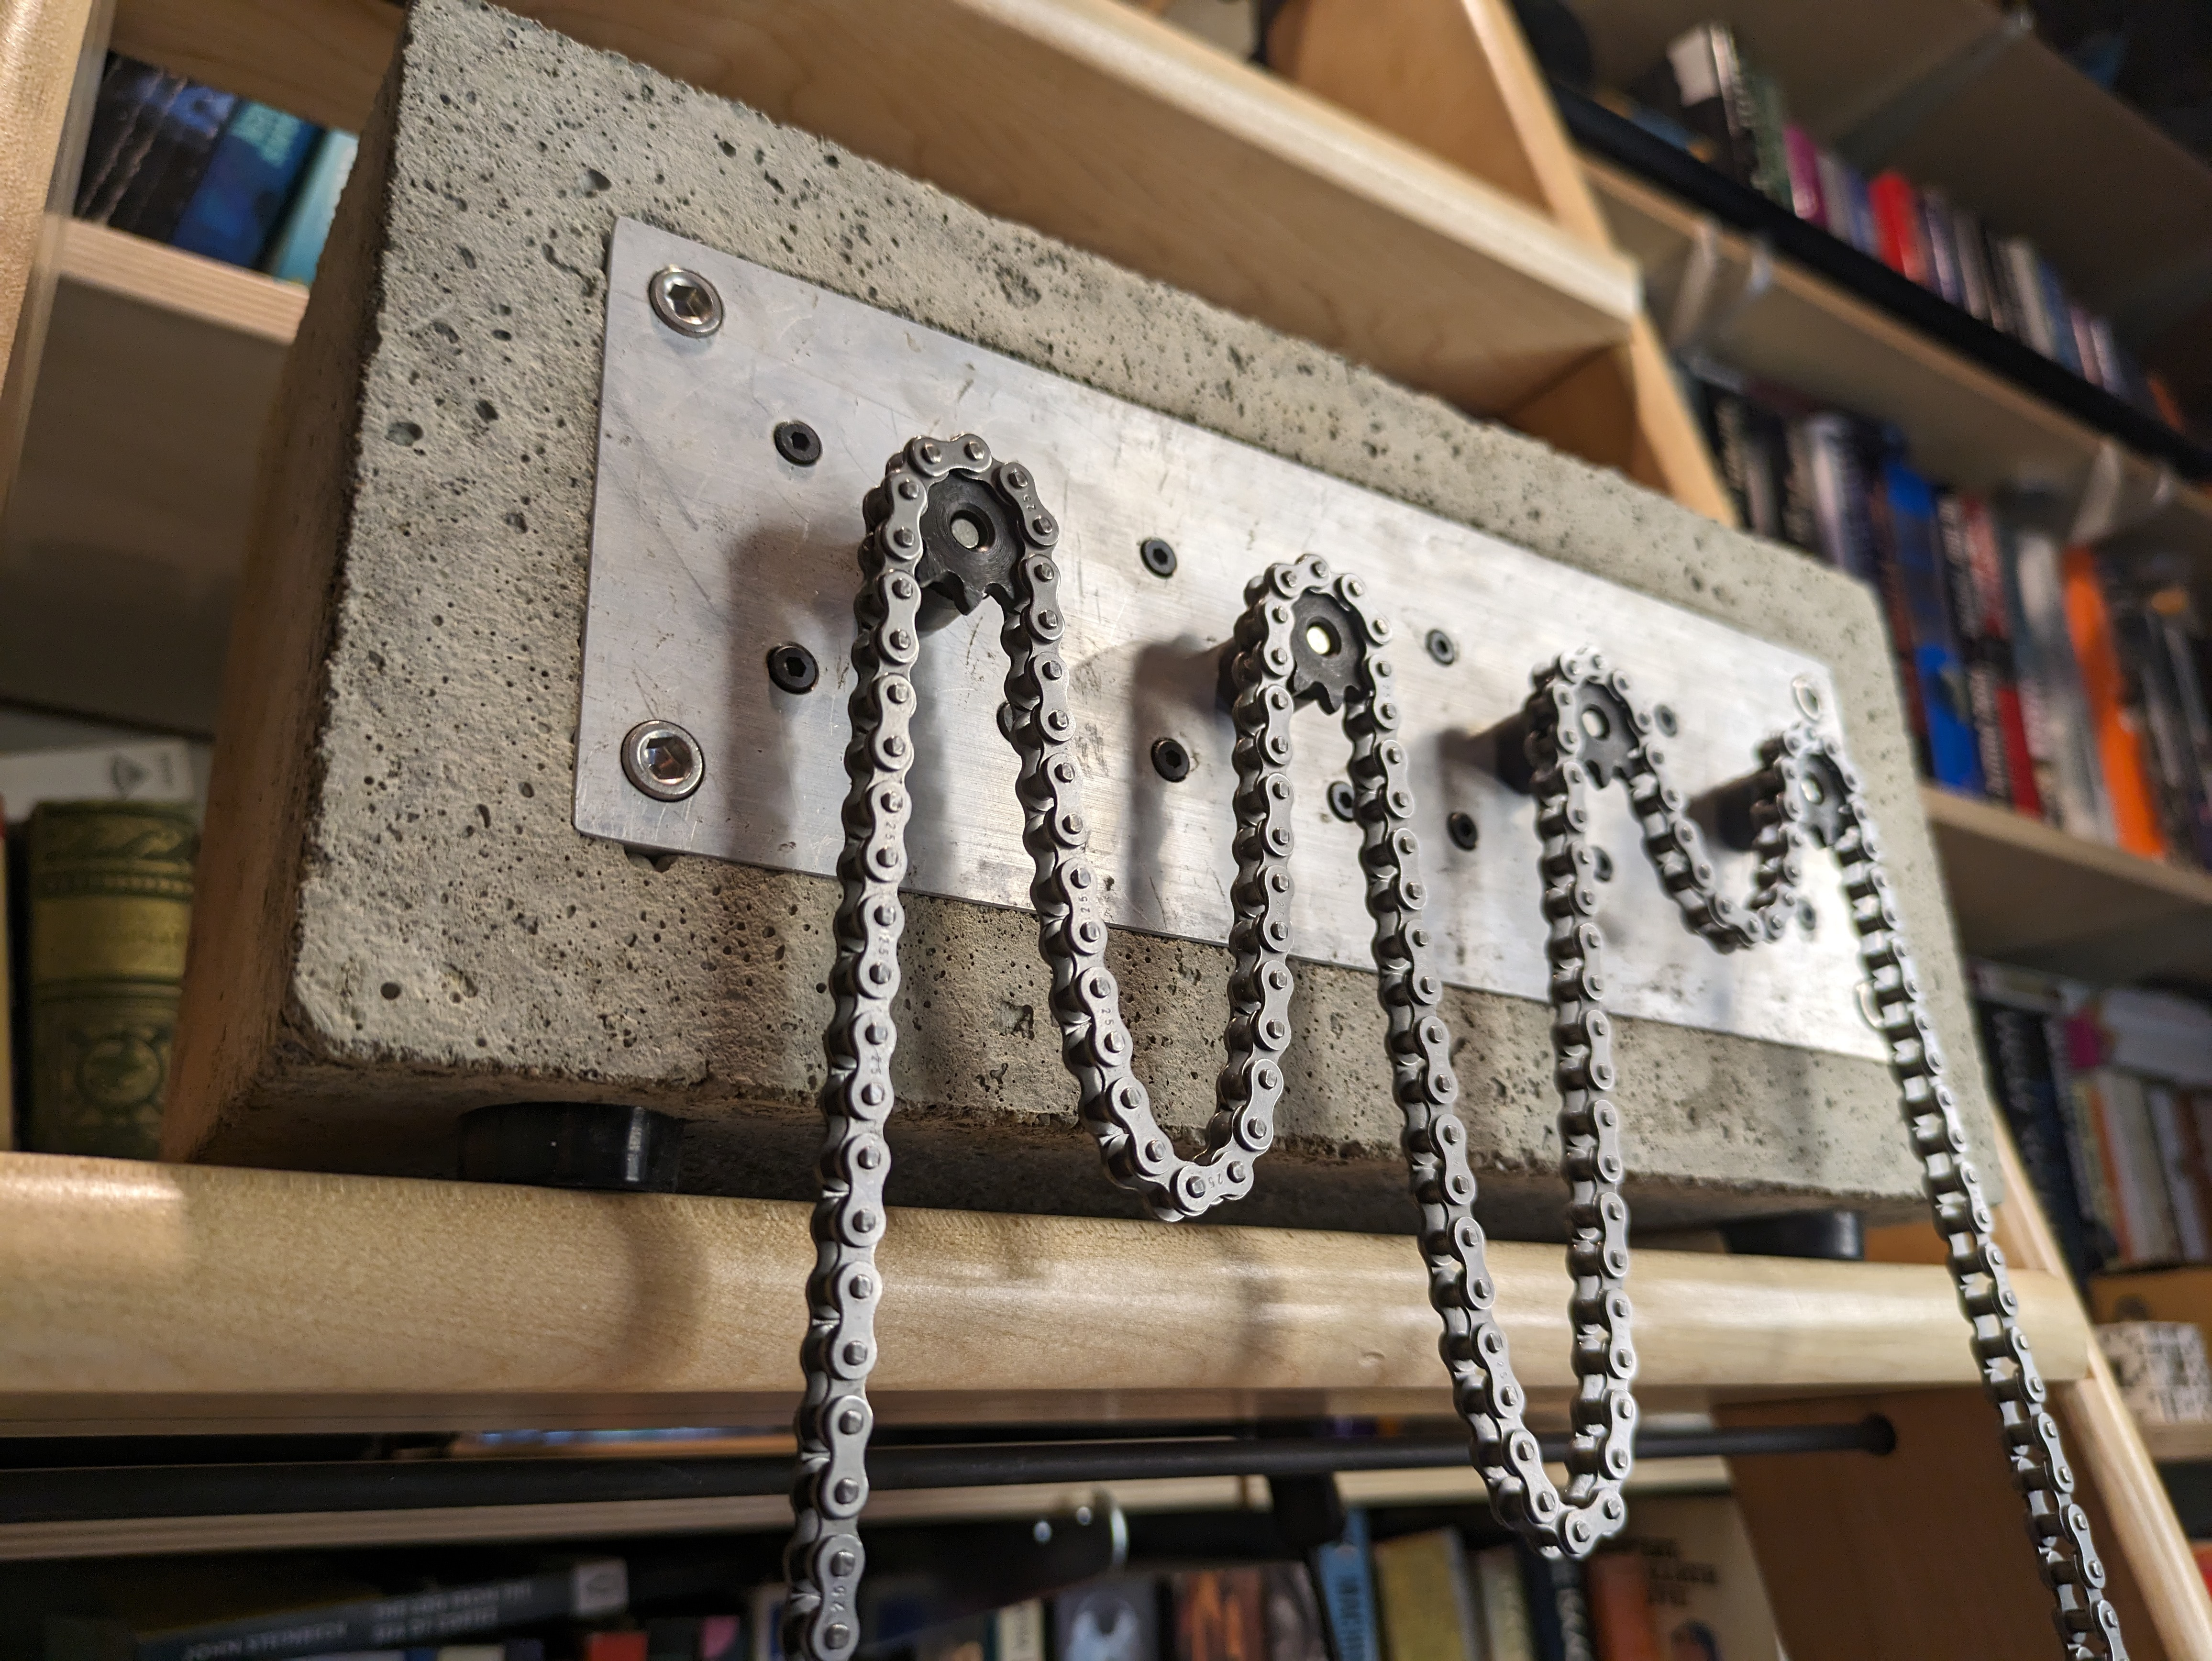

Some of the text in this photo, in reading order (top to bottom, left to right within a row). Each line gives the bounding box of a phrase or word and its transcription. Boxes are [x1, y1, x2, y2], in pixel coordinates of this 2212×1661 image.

[885, 820, 896, 841] 25
[1078, 896, 1091, 913] 25
[878, 936, 890, 956] 25
[1101, 1007, 1115, 1026] 25
[1208, 1172, 1224, 1188] 25
[831, 1584, 846, 1613] 25
